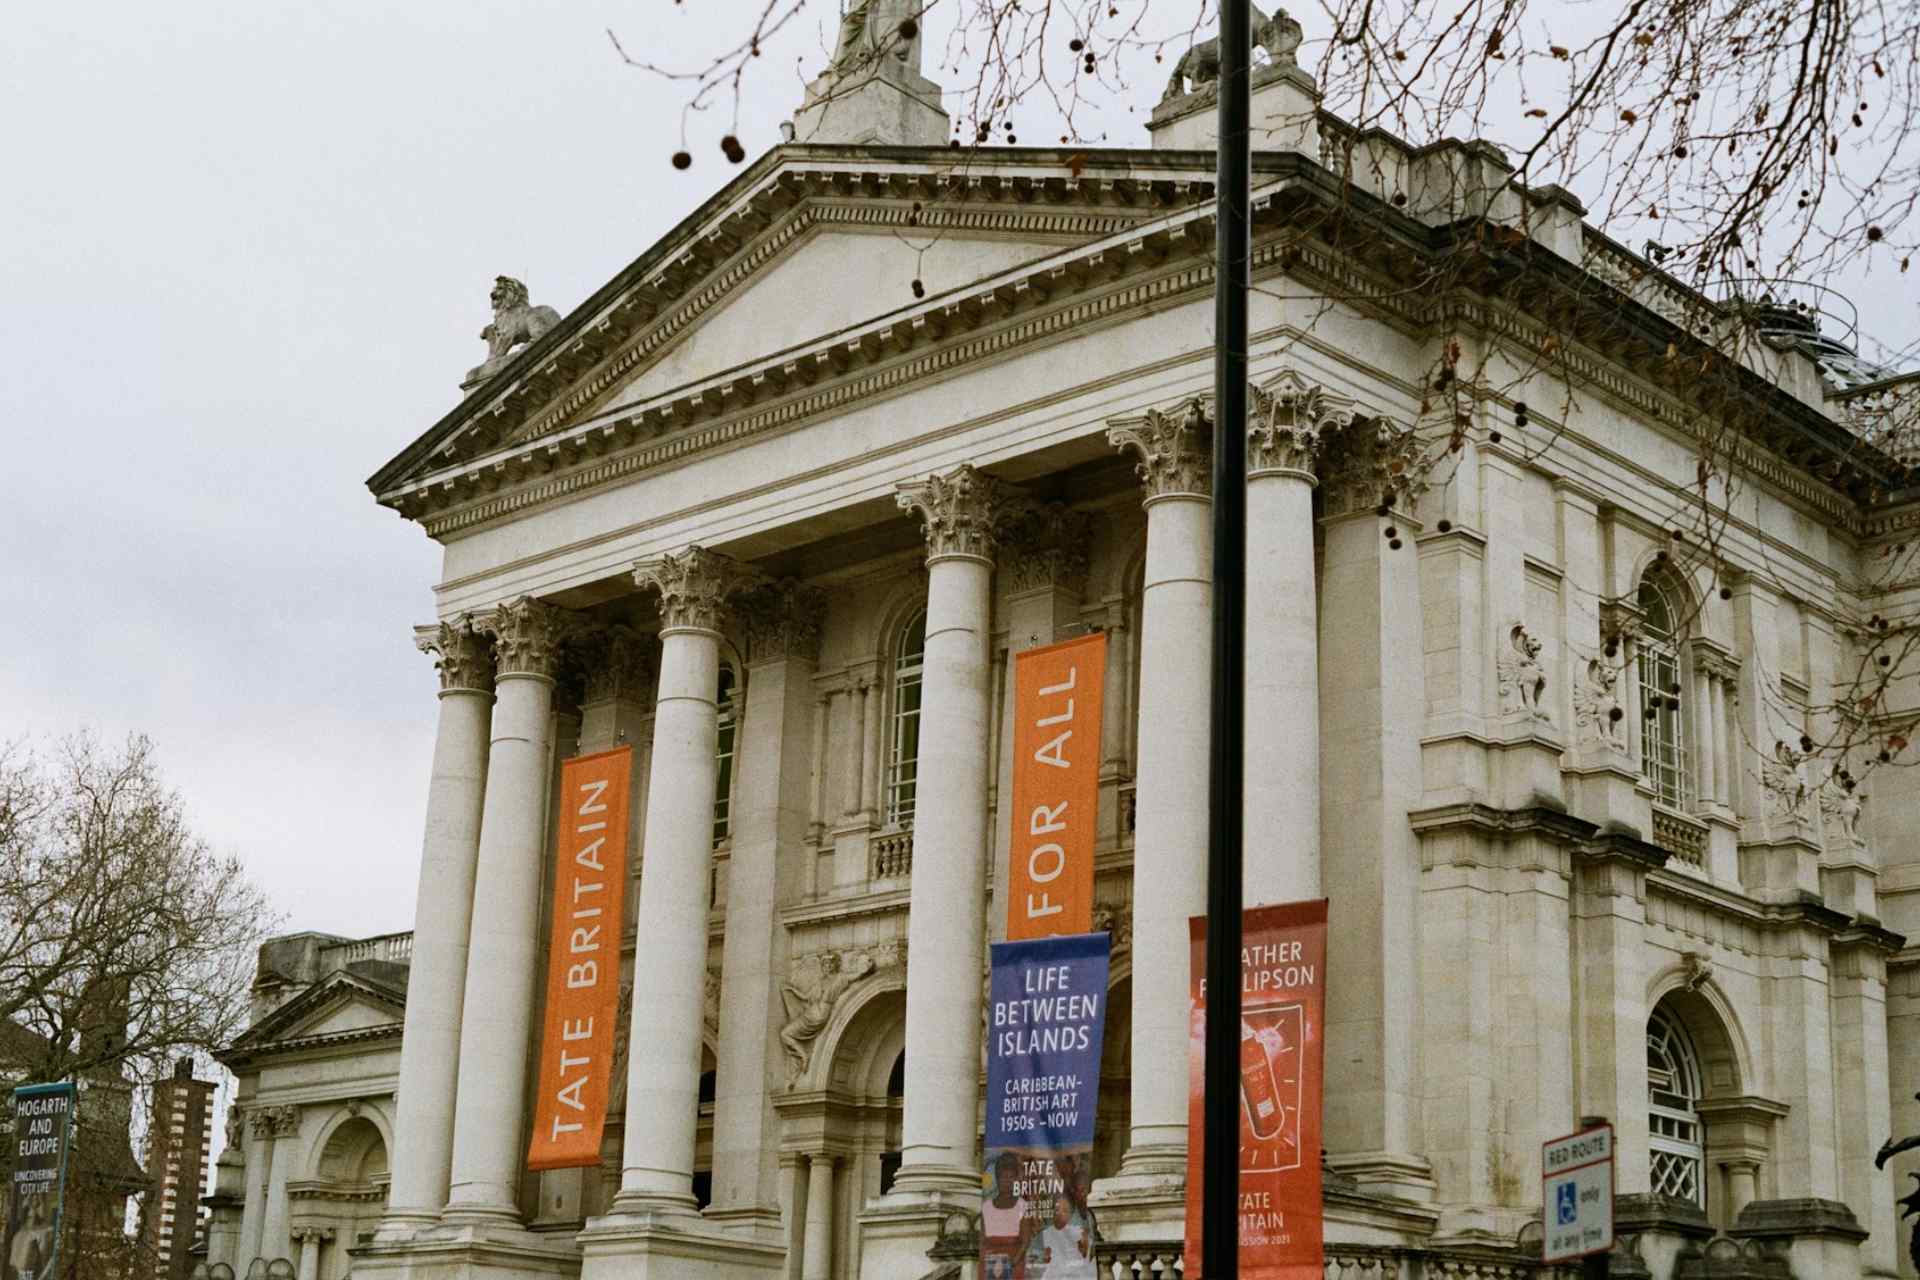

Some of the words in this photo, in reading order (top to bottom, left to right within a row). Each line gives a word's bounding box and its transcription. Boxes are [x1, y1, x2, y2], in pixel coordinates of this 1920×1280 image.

[1034, 666, 1076, 769] ALL
[1026, 800, 1069, 919] FOR
[567, 779, 609, 989] BRITAIN
[1241, 941, 1302, 968] ATHER
[1025, 965, 1070, 993] LIFE
[995, 993, 1098, 1026] BETWEEN
[999, 1025, 1090, 1057] ISLANDS
[551, 1015, 594, 1142] TATE
[17, 1096, 69, 1117] HOGARTH
[1003, 1096, 1049, 1113] BRITISH
[1051, 1092, 1079, 1110] ART
[29, 1118, 53, 1136] AND
[1001, 1114, 1035, 1132] 1950s
[19, 1137, 59, 1156] EUROPE
[1549, 1148, 1570, 1165] RED
[1572, 1136, 1606, 1160] ROUTE
[1023, 1160, 1054, 1177] TATE
[1012, 1179, 1065, 1197] BRITAIN
